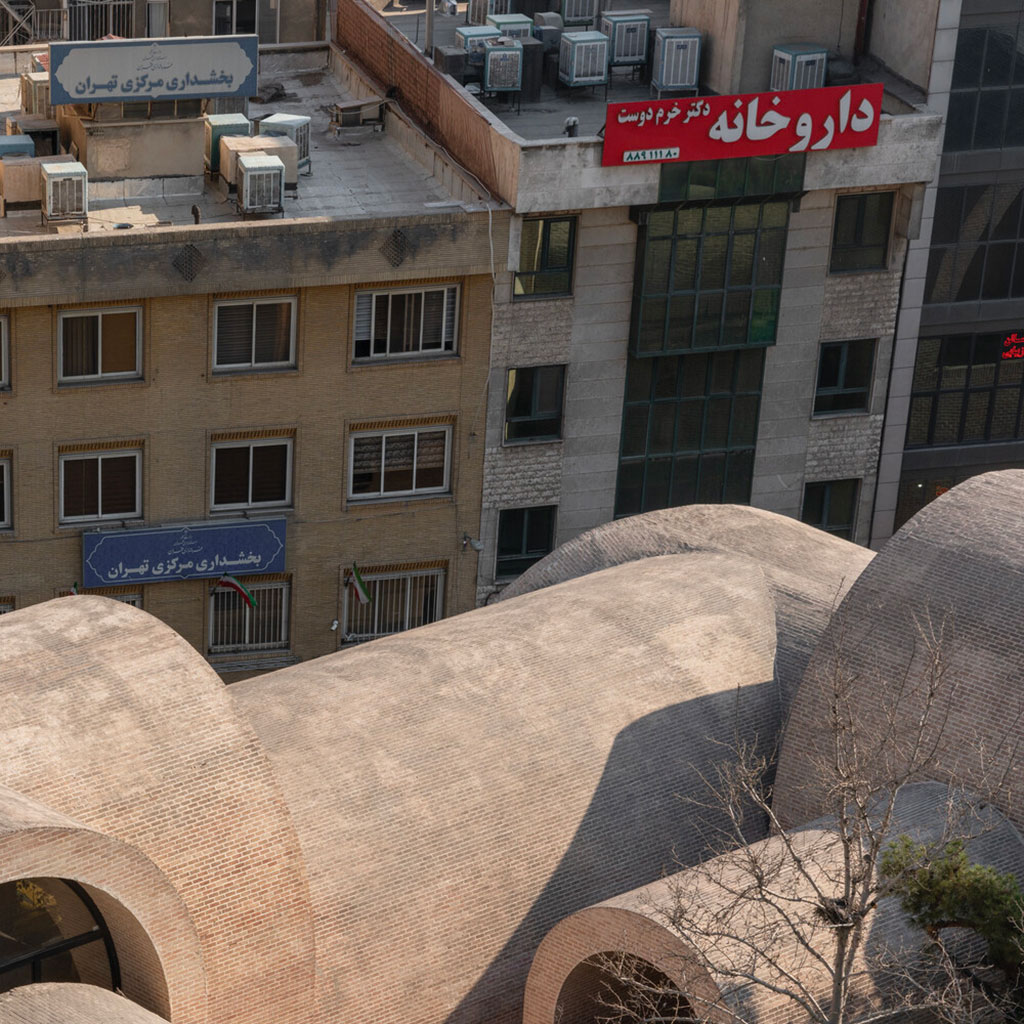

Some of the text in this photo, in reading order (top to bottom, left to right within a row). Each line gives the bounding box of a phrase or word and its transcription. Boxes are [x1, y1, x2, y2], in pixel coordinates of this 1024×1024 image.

[75, 70, 233, 94] بخشداری مرکزی تهران
[682, 99, 711, 124] دکتر
[709, 89, 874, 152] داروخانه
[108, 551, 262, 578] بخشداری مرکزی تهران
